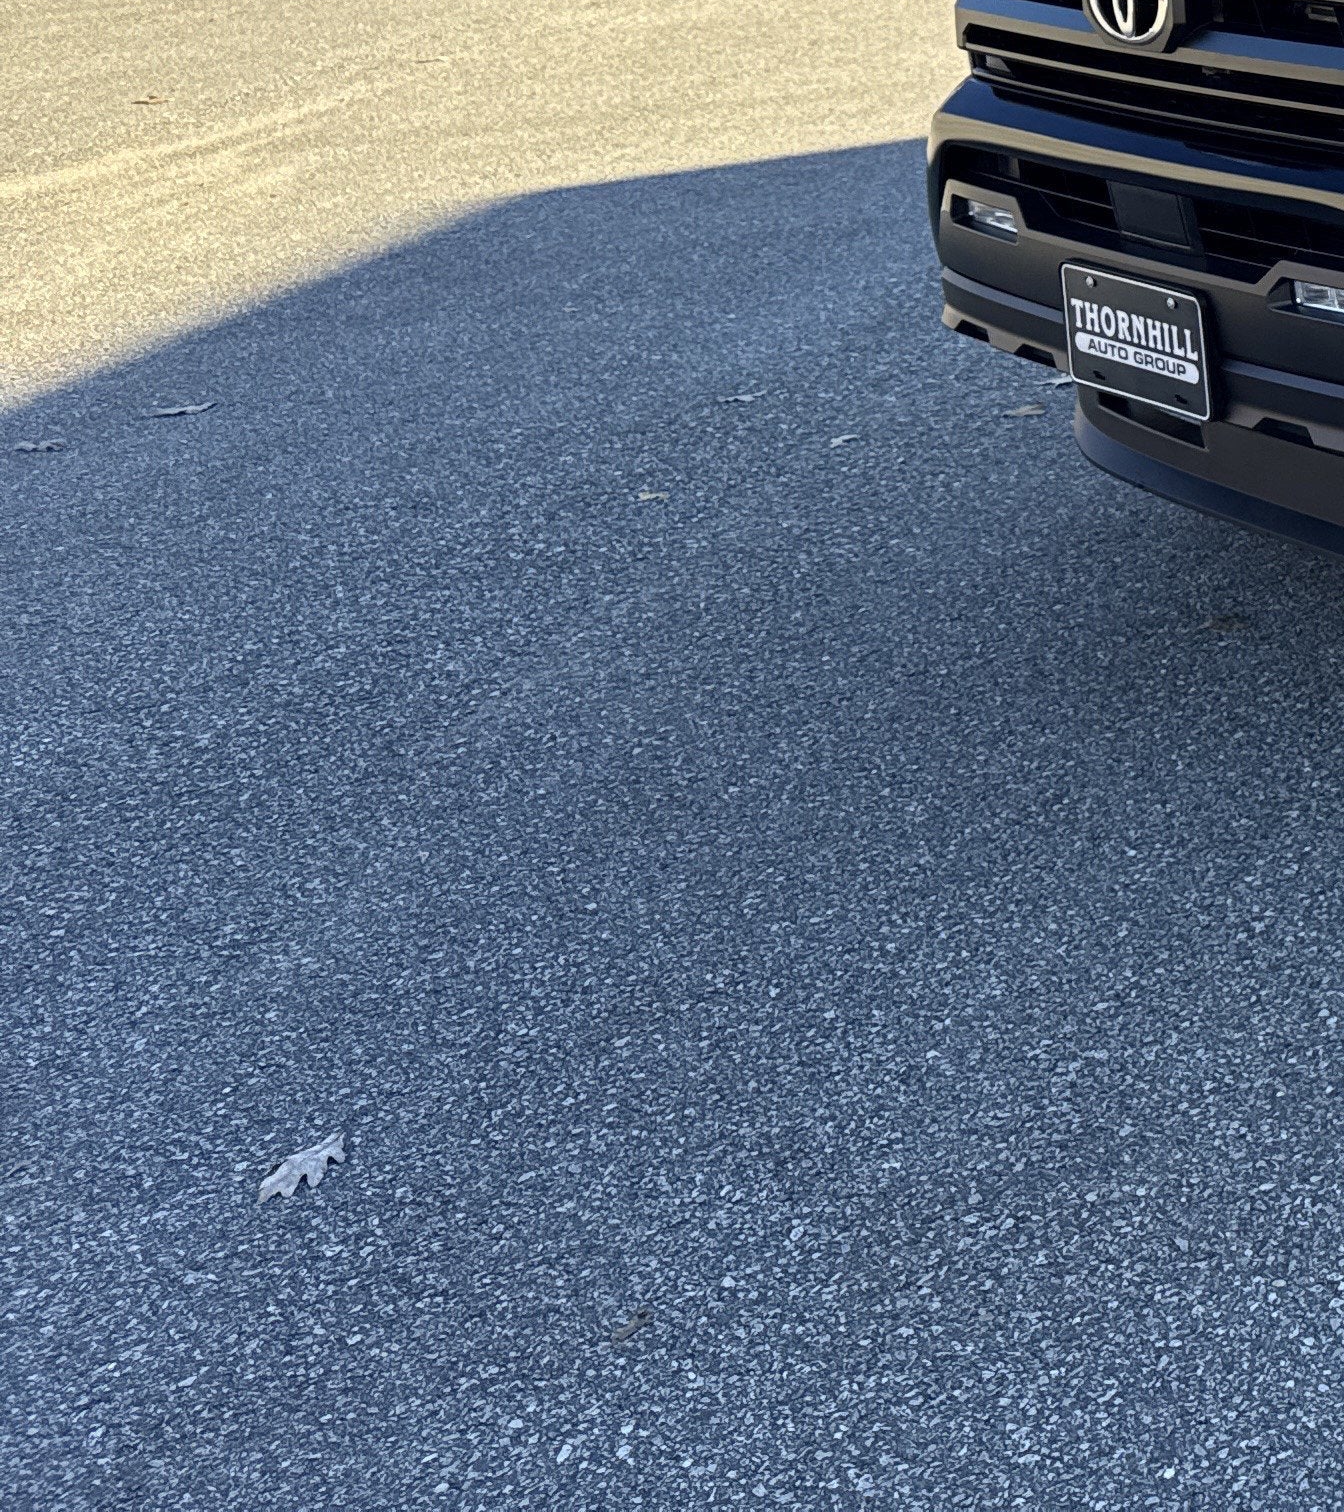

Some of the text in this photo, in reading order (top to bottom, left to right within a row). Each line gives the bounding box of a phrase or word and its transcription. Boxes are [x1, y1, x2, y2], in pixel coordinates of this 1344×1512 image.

[1071, 298, 1198, 361] THORNHILL
[1088, 338, 1187, 376] AUTO GROUP
